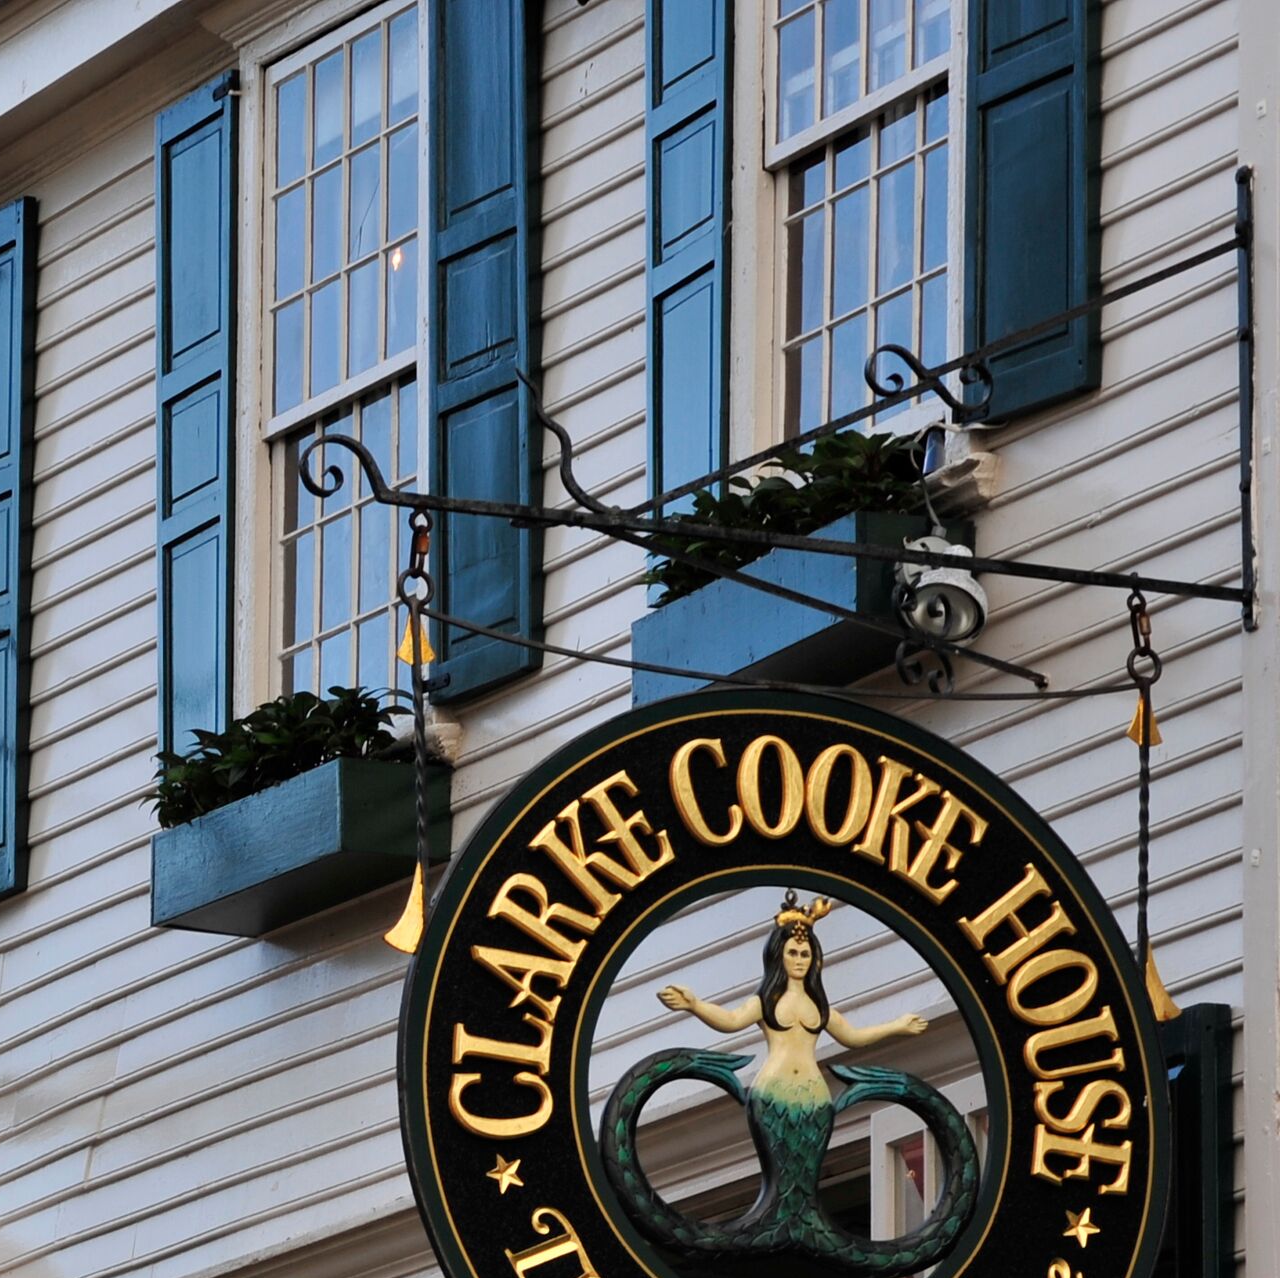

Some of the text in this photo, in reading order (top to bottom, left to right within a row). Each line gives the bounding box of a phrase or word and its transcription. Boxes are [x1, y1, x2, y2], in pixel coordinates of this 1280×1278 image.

[449, 733, 1132, 1195] CLARKE COOKE HOUSE
